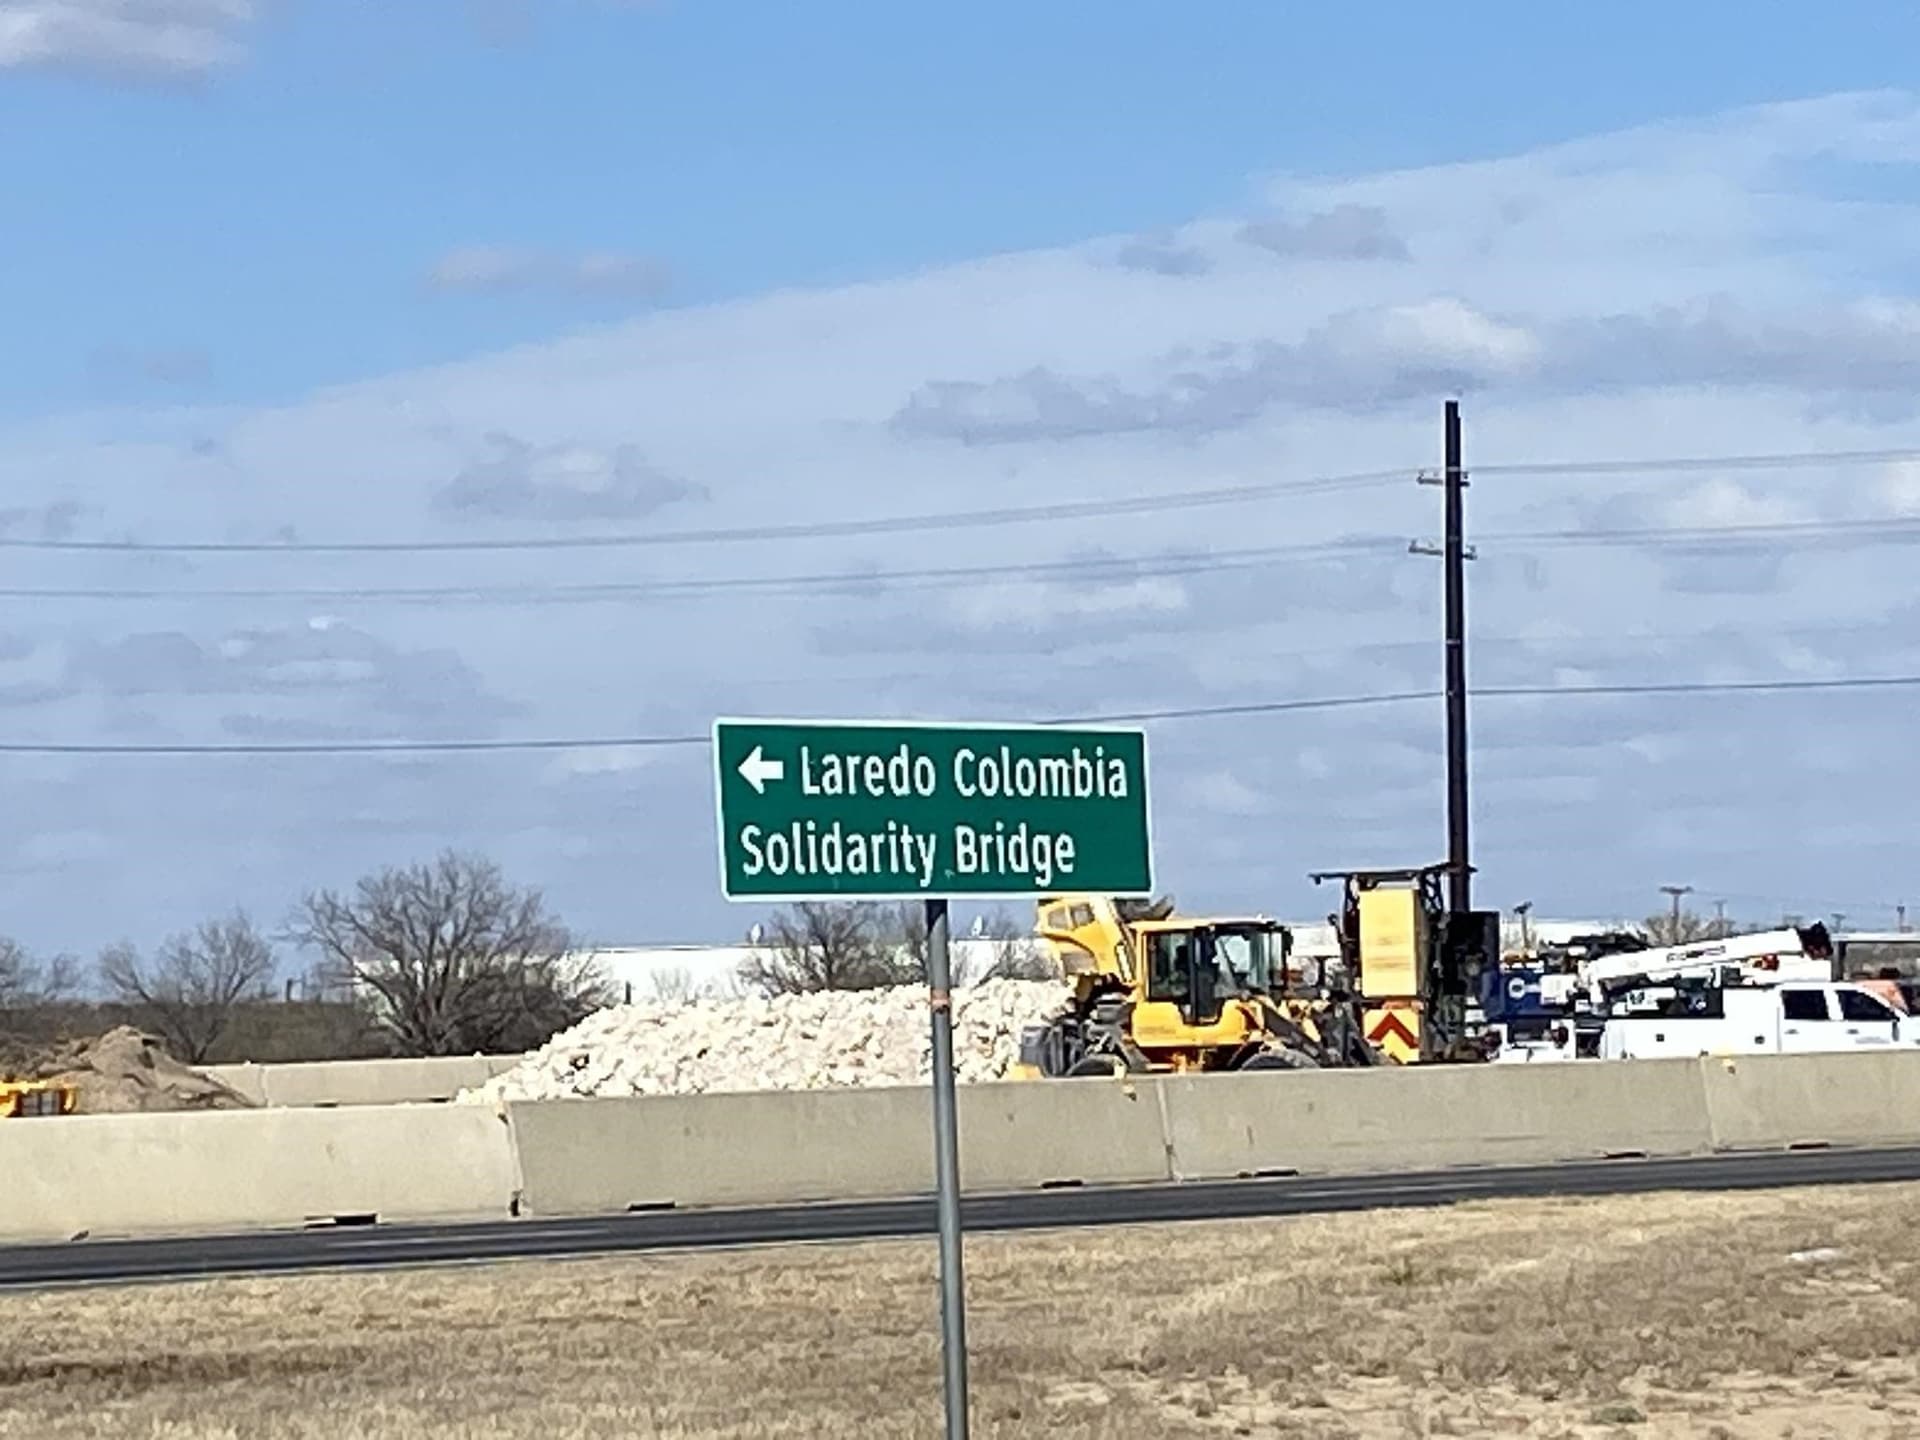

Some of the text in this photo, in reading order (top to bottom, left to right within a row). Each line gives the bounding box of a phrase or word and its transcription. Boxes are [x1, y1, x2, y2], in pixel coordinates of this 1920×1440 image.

[800, 744, 1128, 798] Laredo Colombia
[741, 820, 1075, 887] Solidarity Bridge
